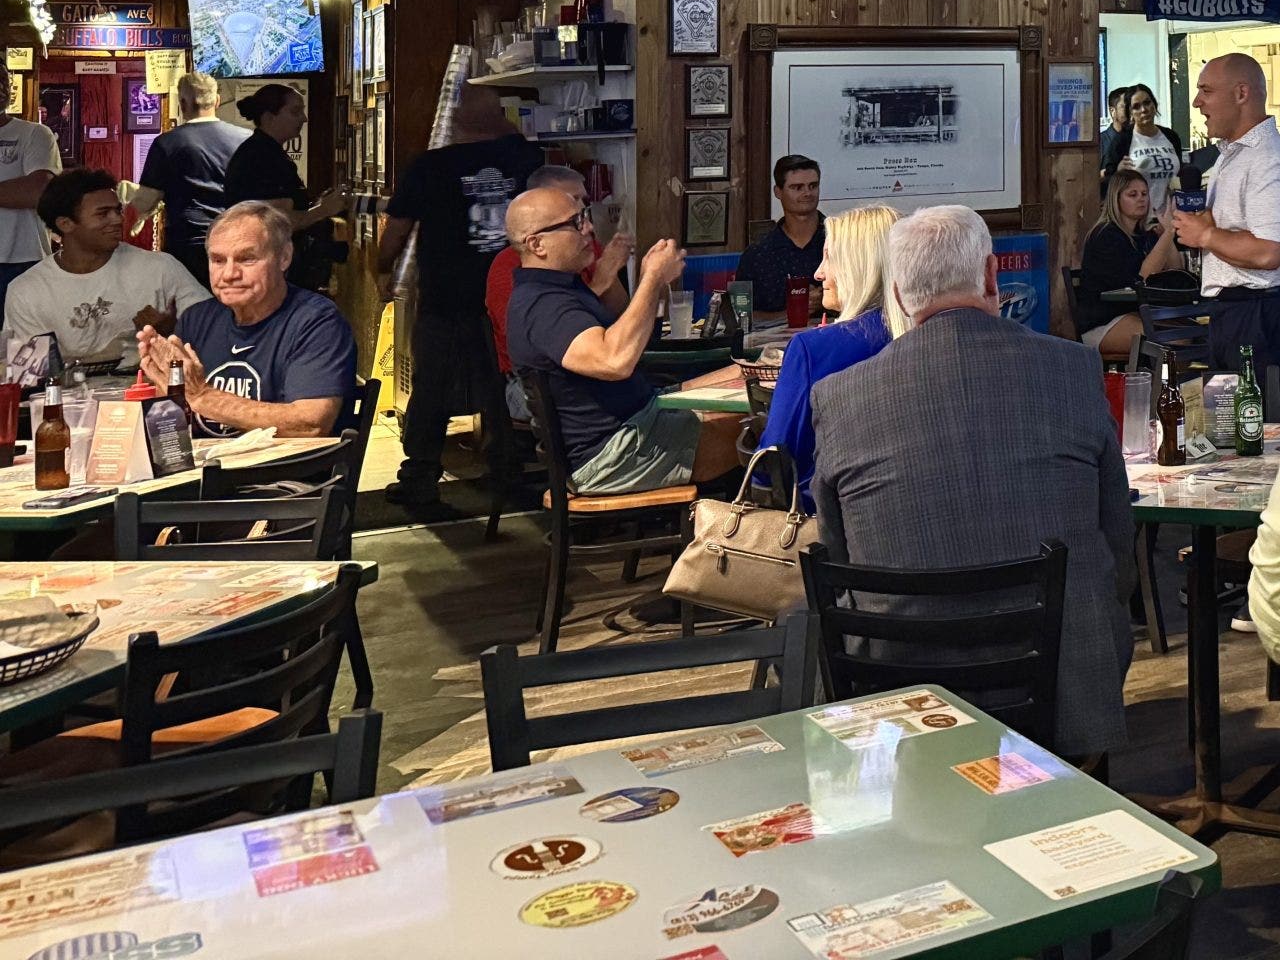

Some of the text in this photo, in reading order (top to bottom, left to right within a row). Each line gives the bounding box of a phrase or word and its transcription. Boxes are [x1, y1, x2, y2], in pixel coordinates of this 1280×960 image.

[127, 9, 147, 19] AVE
[57, 28, 118, 46] BUFFALO
[125, 28, 163, 47] BILLS
[1134, 147, 1160, 157] TAMPA
[1001, 254, 1029, 270] EERS
[213, 376, 253, 399] DAVE
